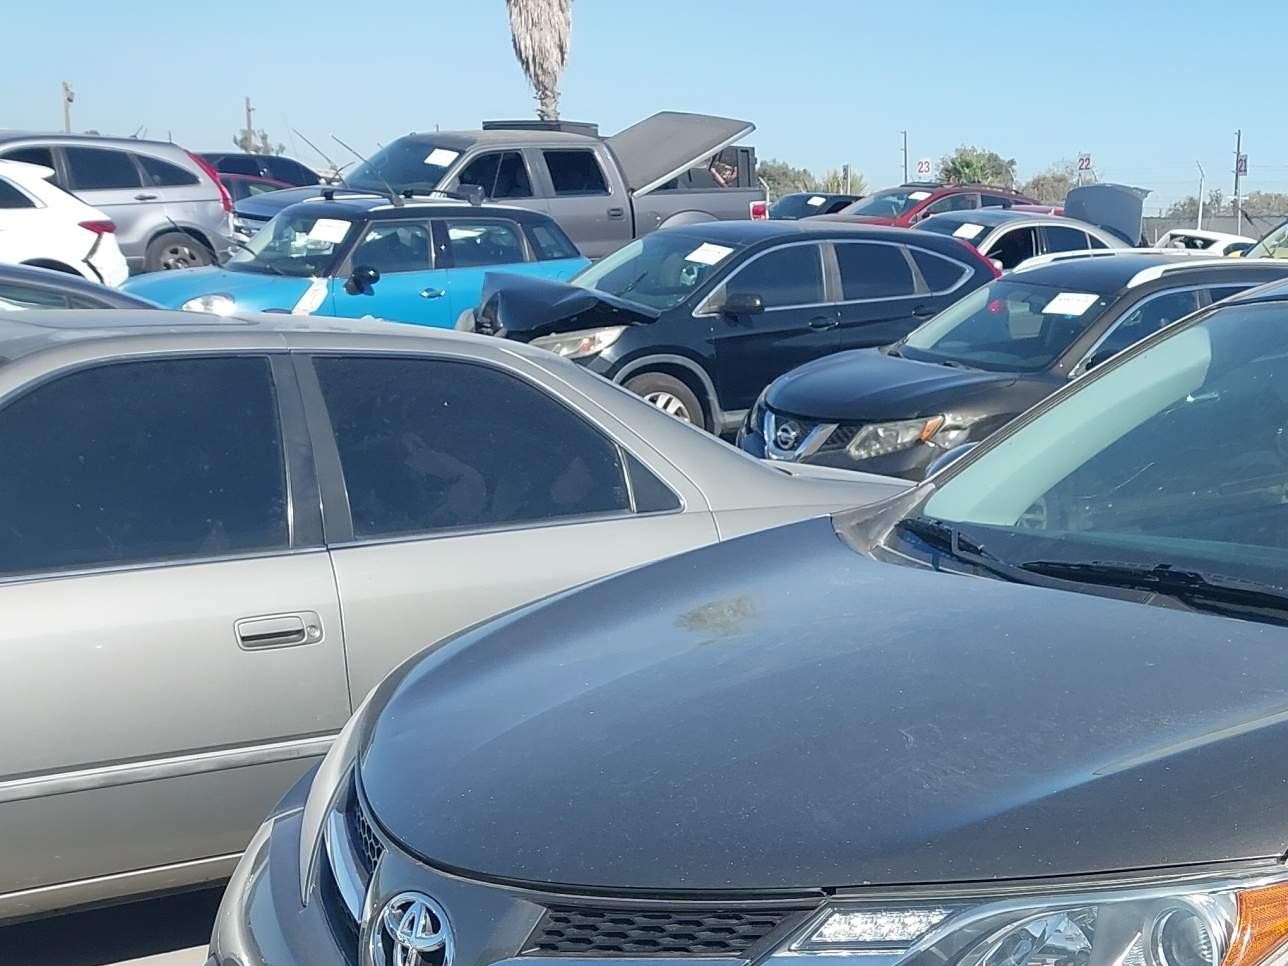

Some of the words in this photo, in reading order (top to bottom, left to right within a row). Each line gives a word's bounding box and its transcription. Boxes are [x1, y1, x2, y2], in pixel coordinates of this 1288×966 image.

[918, 160, 930, 173] 23
[1078, 157, 1091, 171] 22
[1238, 158, 1247, 173] 21
